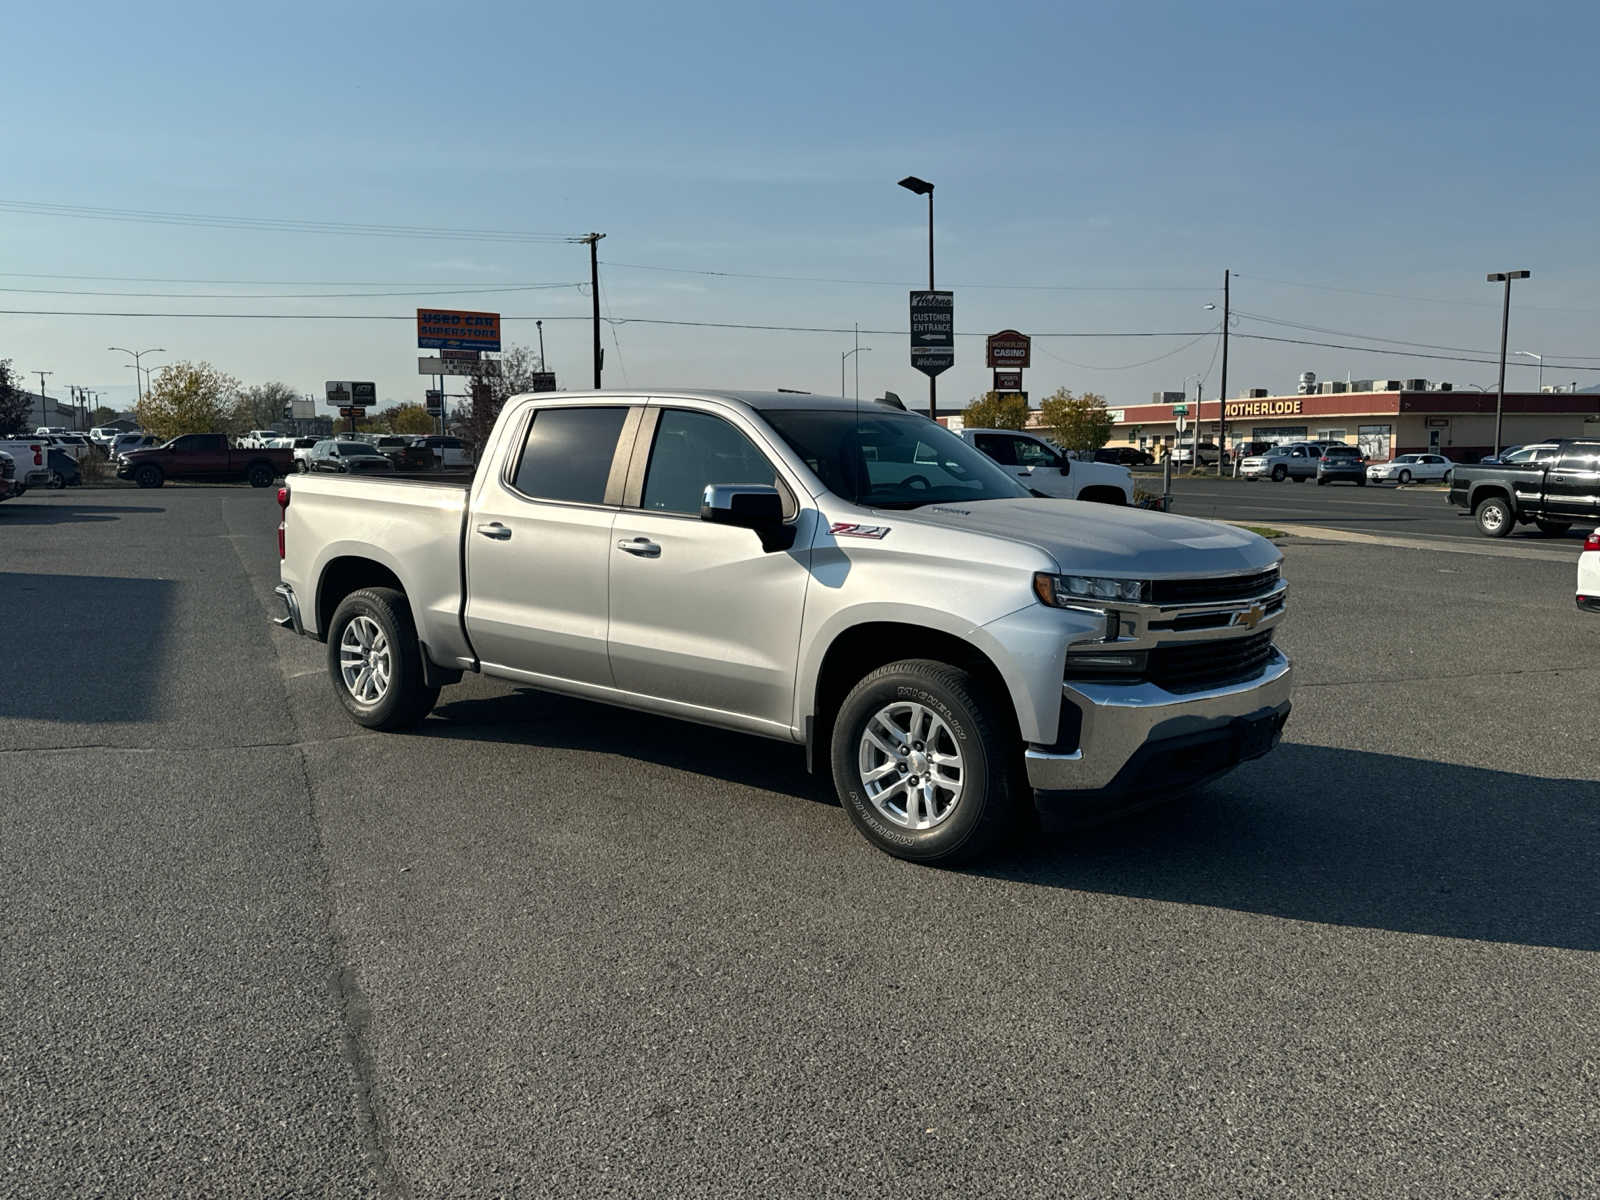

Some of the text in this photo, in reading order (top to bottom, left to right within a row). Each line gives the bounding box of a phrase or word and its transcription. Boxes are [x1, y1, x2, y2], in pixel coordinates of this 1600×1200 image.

[421, 313, 494, 327] USED CAR
[912, 313, 951, 322] CUSTOMER
[421, 326, 497, 338] SUPERSTORE
[913, 323, 952, 332] ENTRANCE
[994, 348, 1026, 357] CASINO
[828, 522, 892, 540] Z71
[897, 686, 967, 740] MICHELIN
